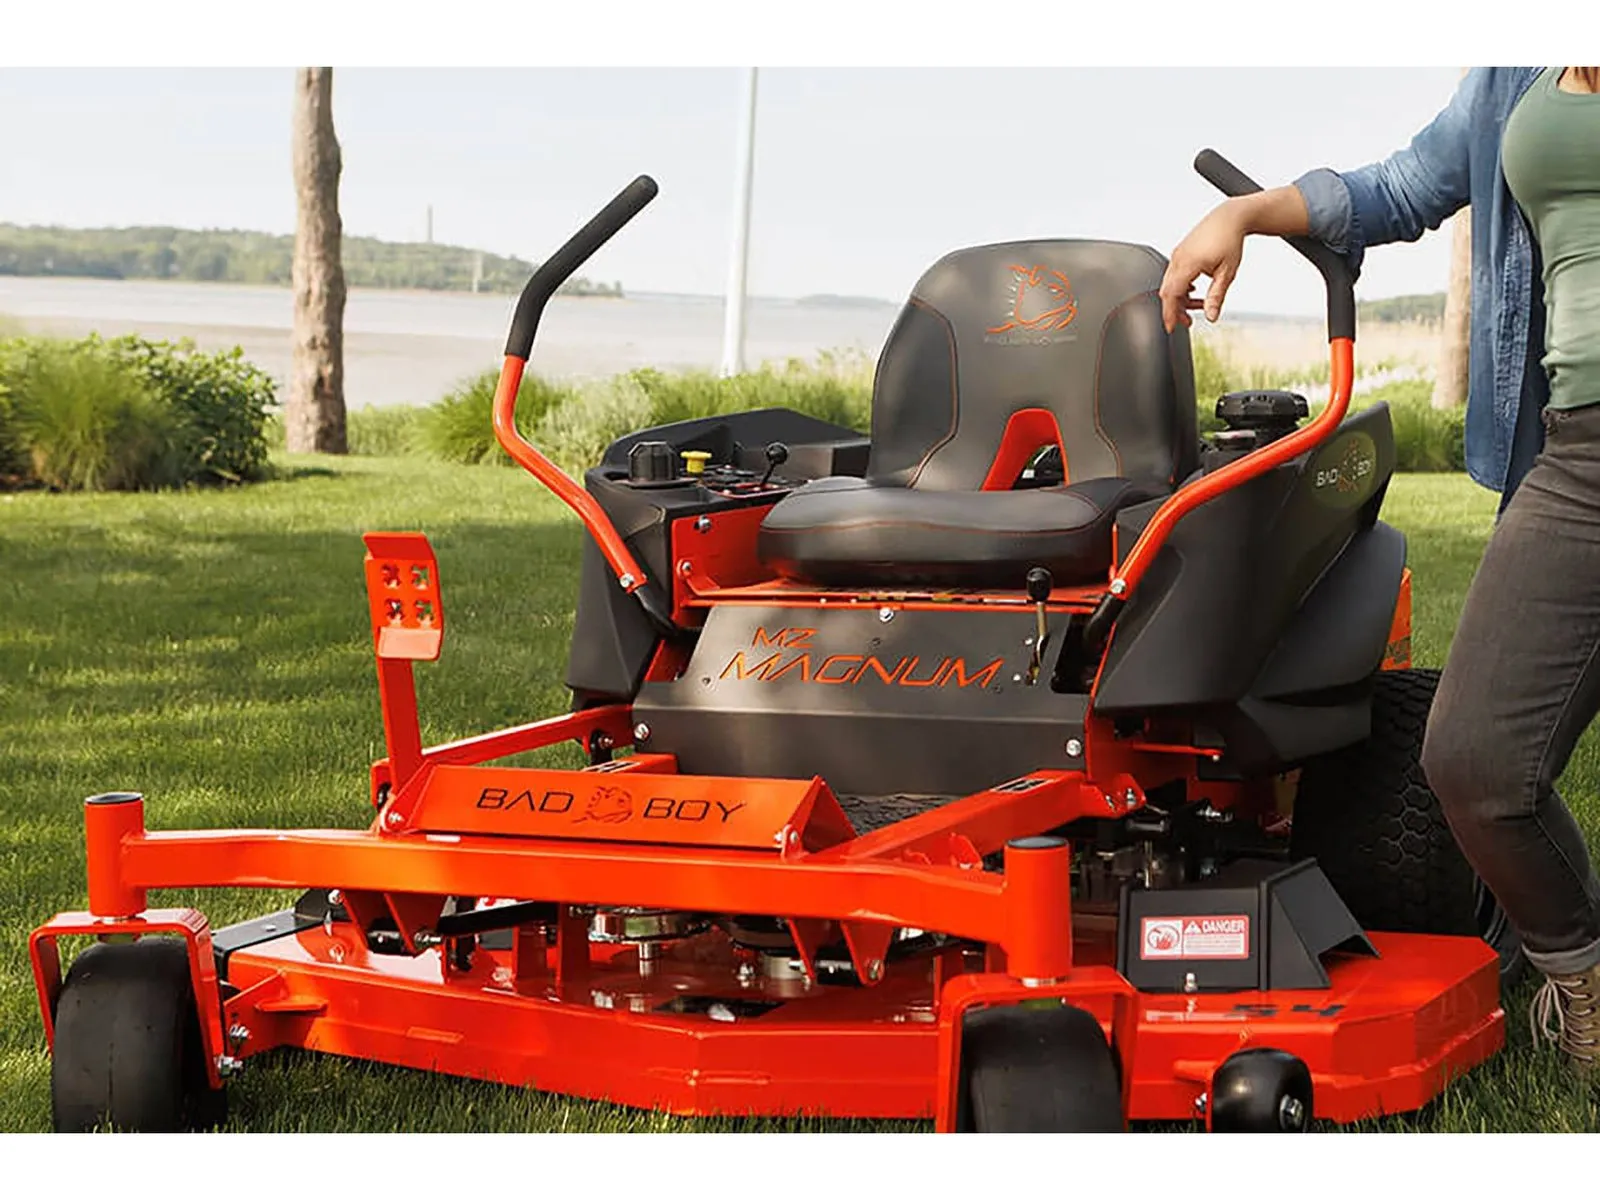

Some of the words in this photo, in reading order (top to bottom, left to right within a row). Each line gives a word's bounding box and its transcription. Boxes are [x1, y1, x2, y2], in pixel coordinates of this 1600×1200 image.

[719, 651, 1005, 688] MAGNUM
[476, 787, 575, 813] BAD
[643, 798, 745, 823] BOY
[1202, 920, 1246, 934] DANGER
